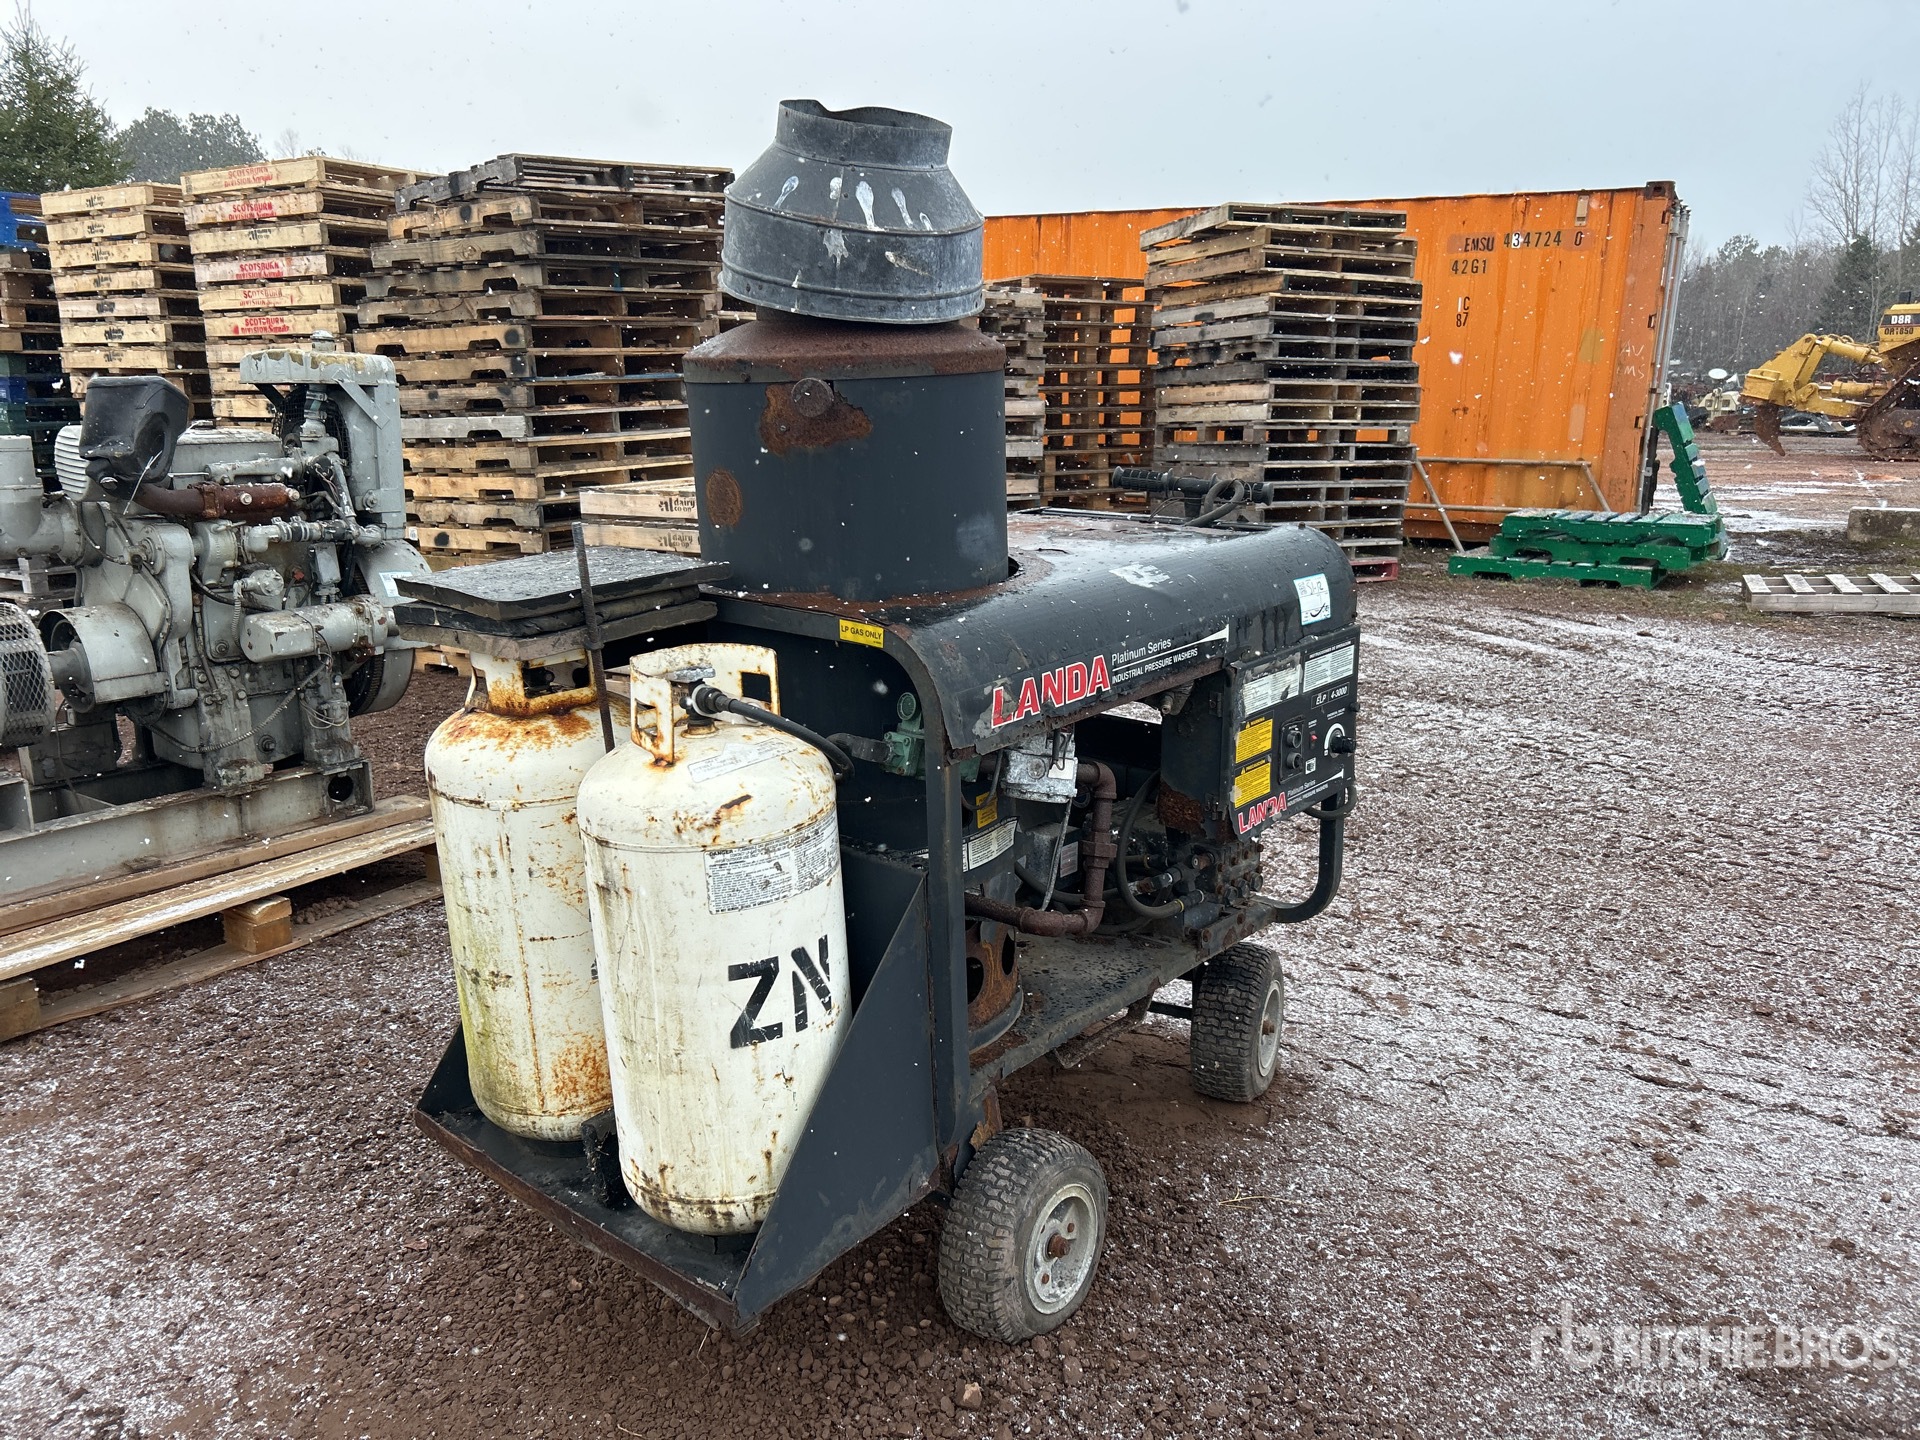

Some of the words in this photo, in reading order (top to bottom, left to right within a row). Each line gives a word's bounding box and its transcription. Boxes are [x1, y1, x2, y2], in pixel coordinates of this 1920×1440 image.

[228, 167, 269, 179] SCOTSBURN
[233, 202, 273, 213] SCOTSBURN
[1464, 237, 1495, 252] EMSU
[1503, 231, 1562, 249] 434724
[239, 261, 280, 272] SCOTSBURN
[1451, 259, 1487, 274] 42G1
[245, 316, 285, 326] SCOTSBURN
[1456, 312, 1469, 327] 87
[1891, 315, 1912, 324] D8R
[674, 498, 695, 508] dairy
[672, 534, 693, 544] dairy
[850, 627, 864, 636] GAS
[865, 630, 882, 640] ONLY
[1111, 646, 1146, 666] Platinum
[1147, 638, 1172, 654] Series
[1112, 665, 1144, 684] INDUSTRIAL
[1144, 655, 1173, 673] PRESSURE
[1173, 648, 1198, 663] WASHERS
[991, 654, 1111, 729] LANDA
[1331, 686, 1348, 699] 4-3000
[1238, 791, 1288, 834] LANDA
[728, 934, 832, 1049] ZN
